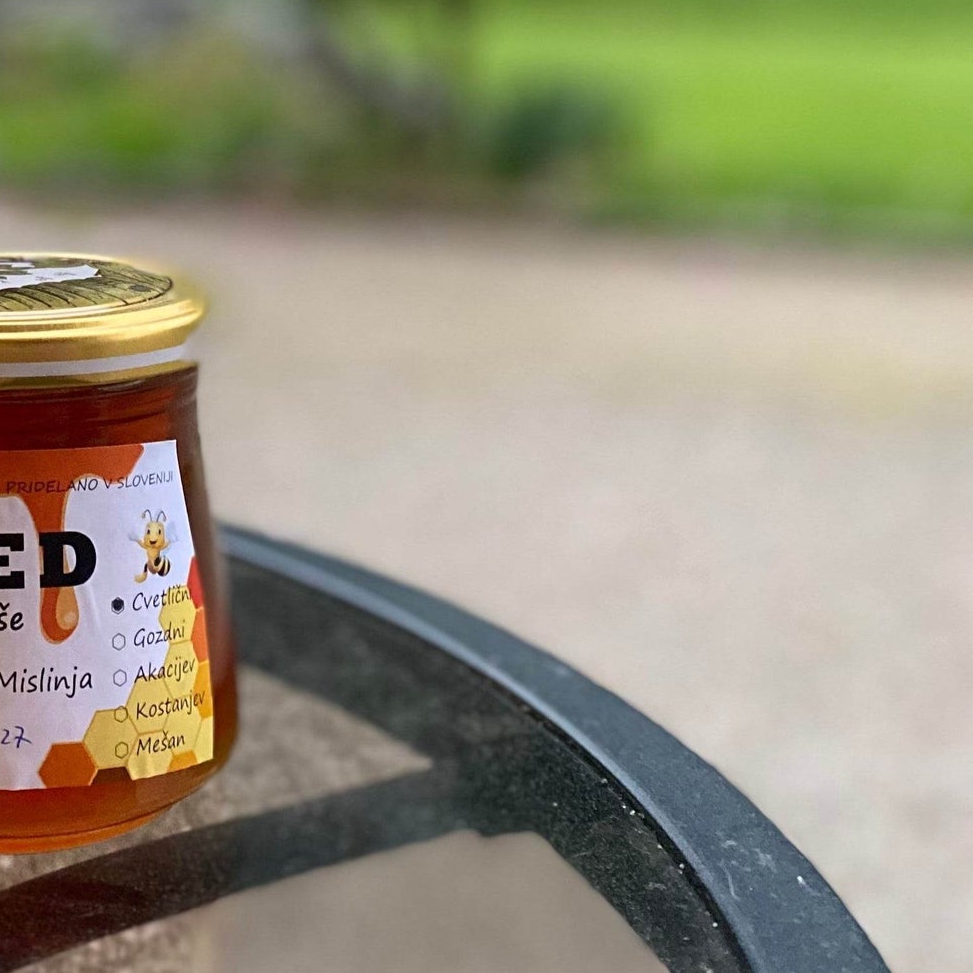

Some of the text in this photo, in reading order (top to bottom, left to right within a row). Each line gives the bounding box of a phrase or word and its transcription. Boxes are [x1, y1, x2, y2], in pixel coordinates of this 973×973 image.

[6, 471, 173, 494] PRIDELANO V SLOVENIJI
[133, 619, 186, 648] Gozdni
[134, 656, 196, 684] Akacijev
[136, 689, 206, 720] Kostanjev
[136, 730, 186, 757] Mešan
